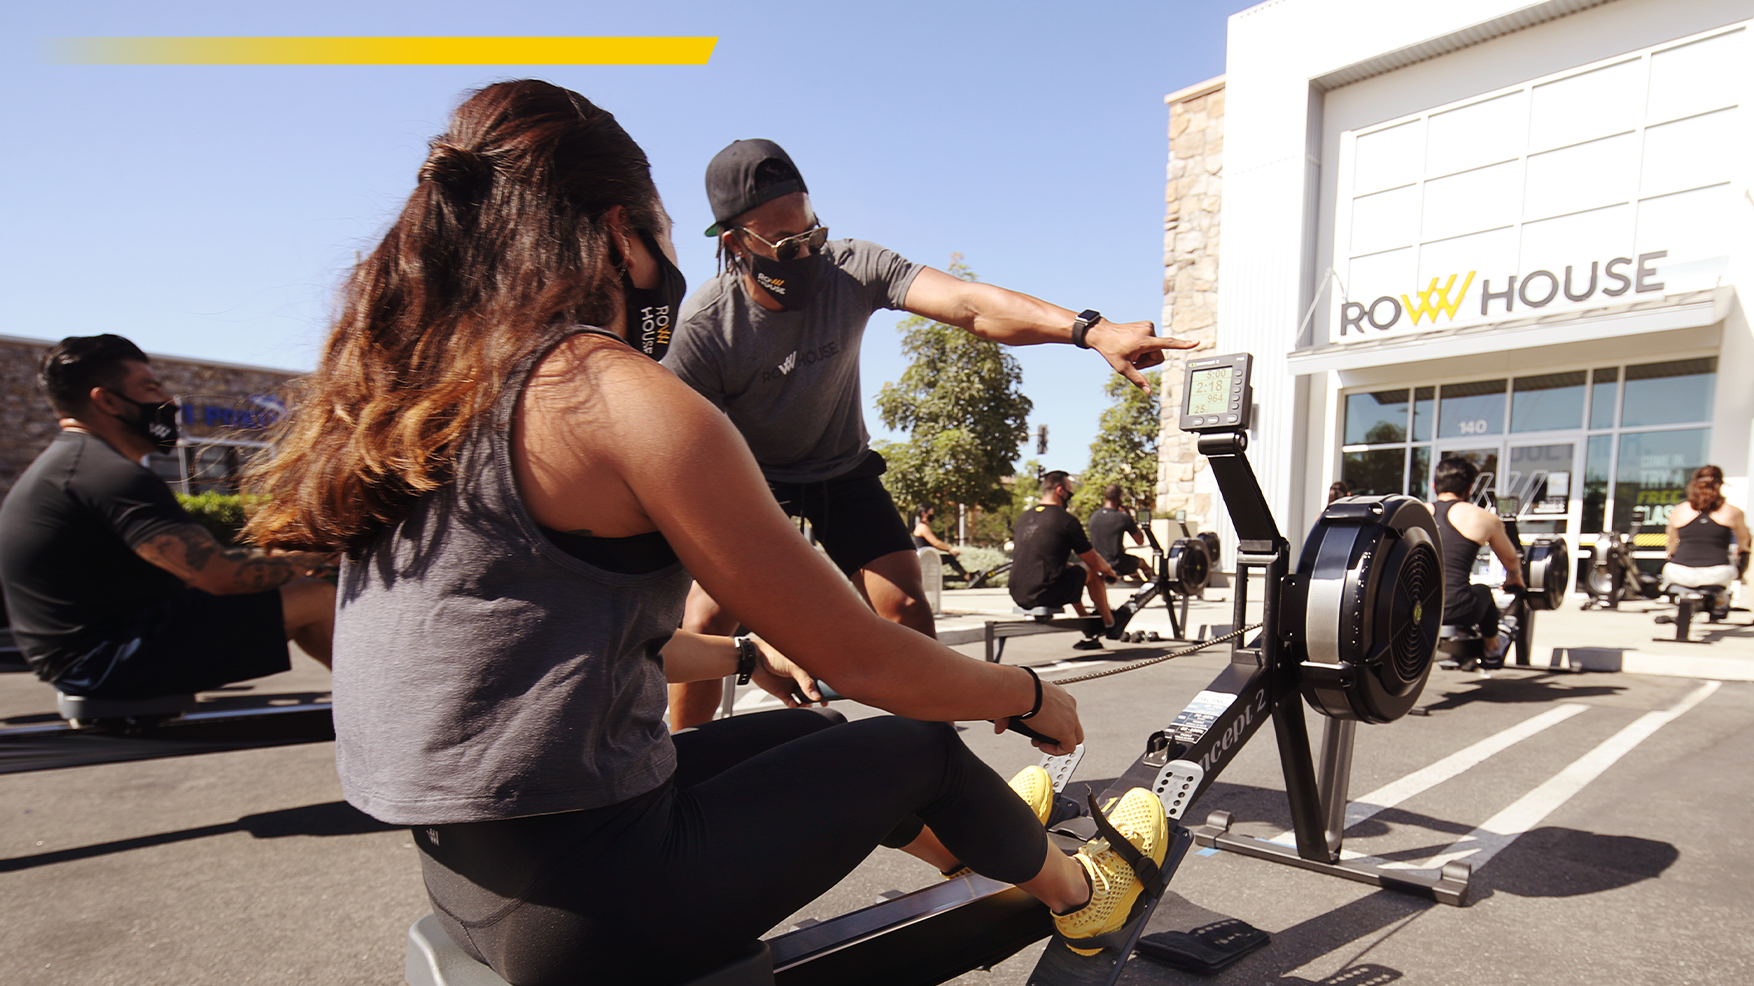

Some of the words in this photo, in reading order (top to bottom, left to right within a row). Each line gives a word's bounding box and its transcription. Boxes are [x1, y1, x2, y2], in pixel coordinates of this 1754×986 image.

[1340, 270, 1477, 336] ROW
[1480, 250, 1668, 316] HOUSE
[798, 341, 840, 367] HOUSE
[1207, 369, 1226, 379] 5:00
[1196, 379, 1223, 394] 2:18
[1207, 394, 1223, 403] 964
[1458, 419, 1488, 435] 140
[1640, 469, 1671, 489] TRY
[1636, 490, 1683, 504] FREE
[1198, 704, 1254, 772] ncept
[1255, 688, 1267, 713] 2
